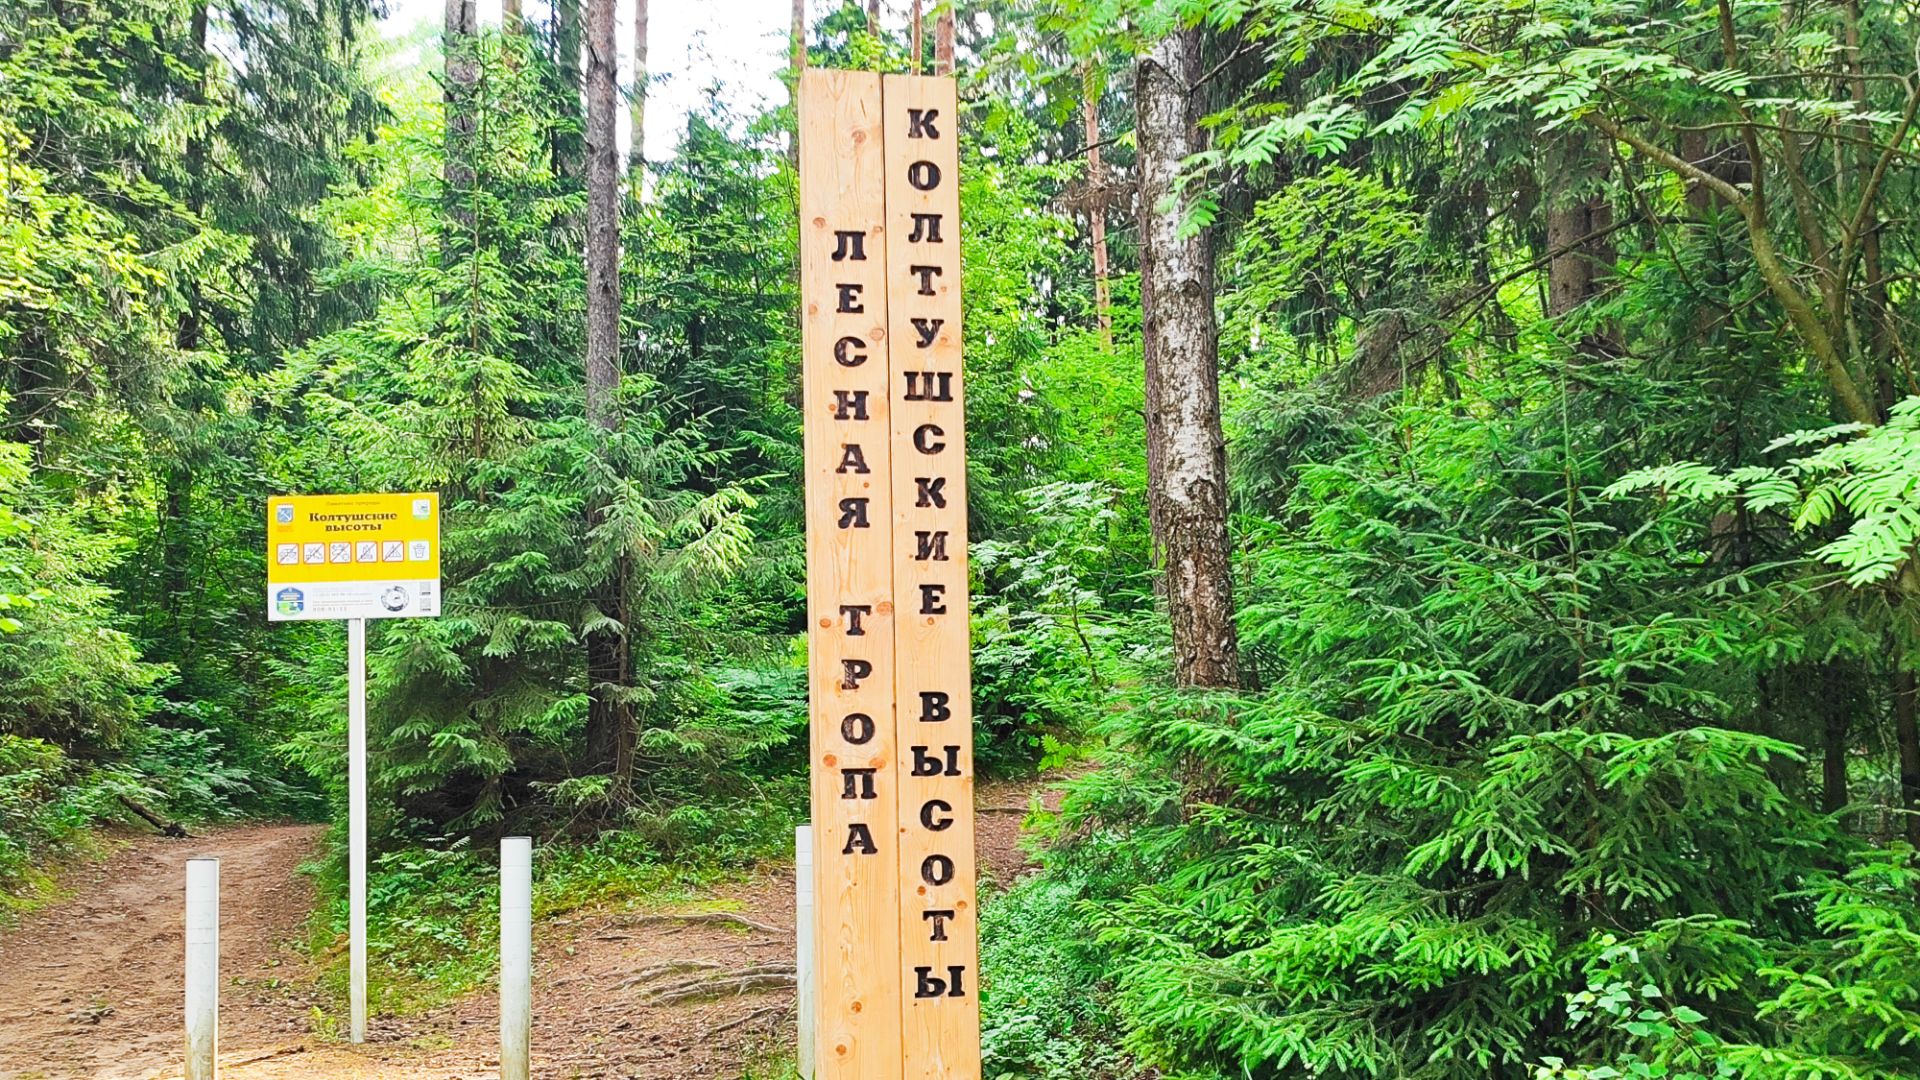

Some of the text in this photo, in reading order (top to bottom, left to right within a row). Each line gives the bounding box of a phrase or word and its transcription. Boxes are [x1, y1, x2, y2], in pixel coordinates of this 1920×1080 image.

[309, 512, 398, 522] Колтушские
[325, 523, 382, 532] высоты
[832, 230, 878, 855] ЛЕСНАЯ ТРОПА
[903, 108, 965, 998] КОЛТУШСКИЕ ВЫСОТЫ
